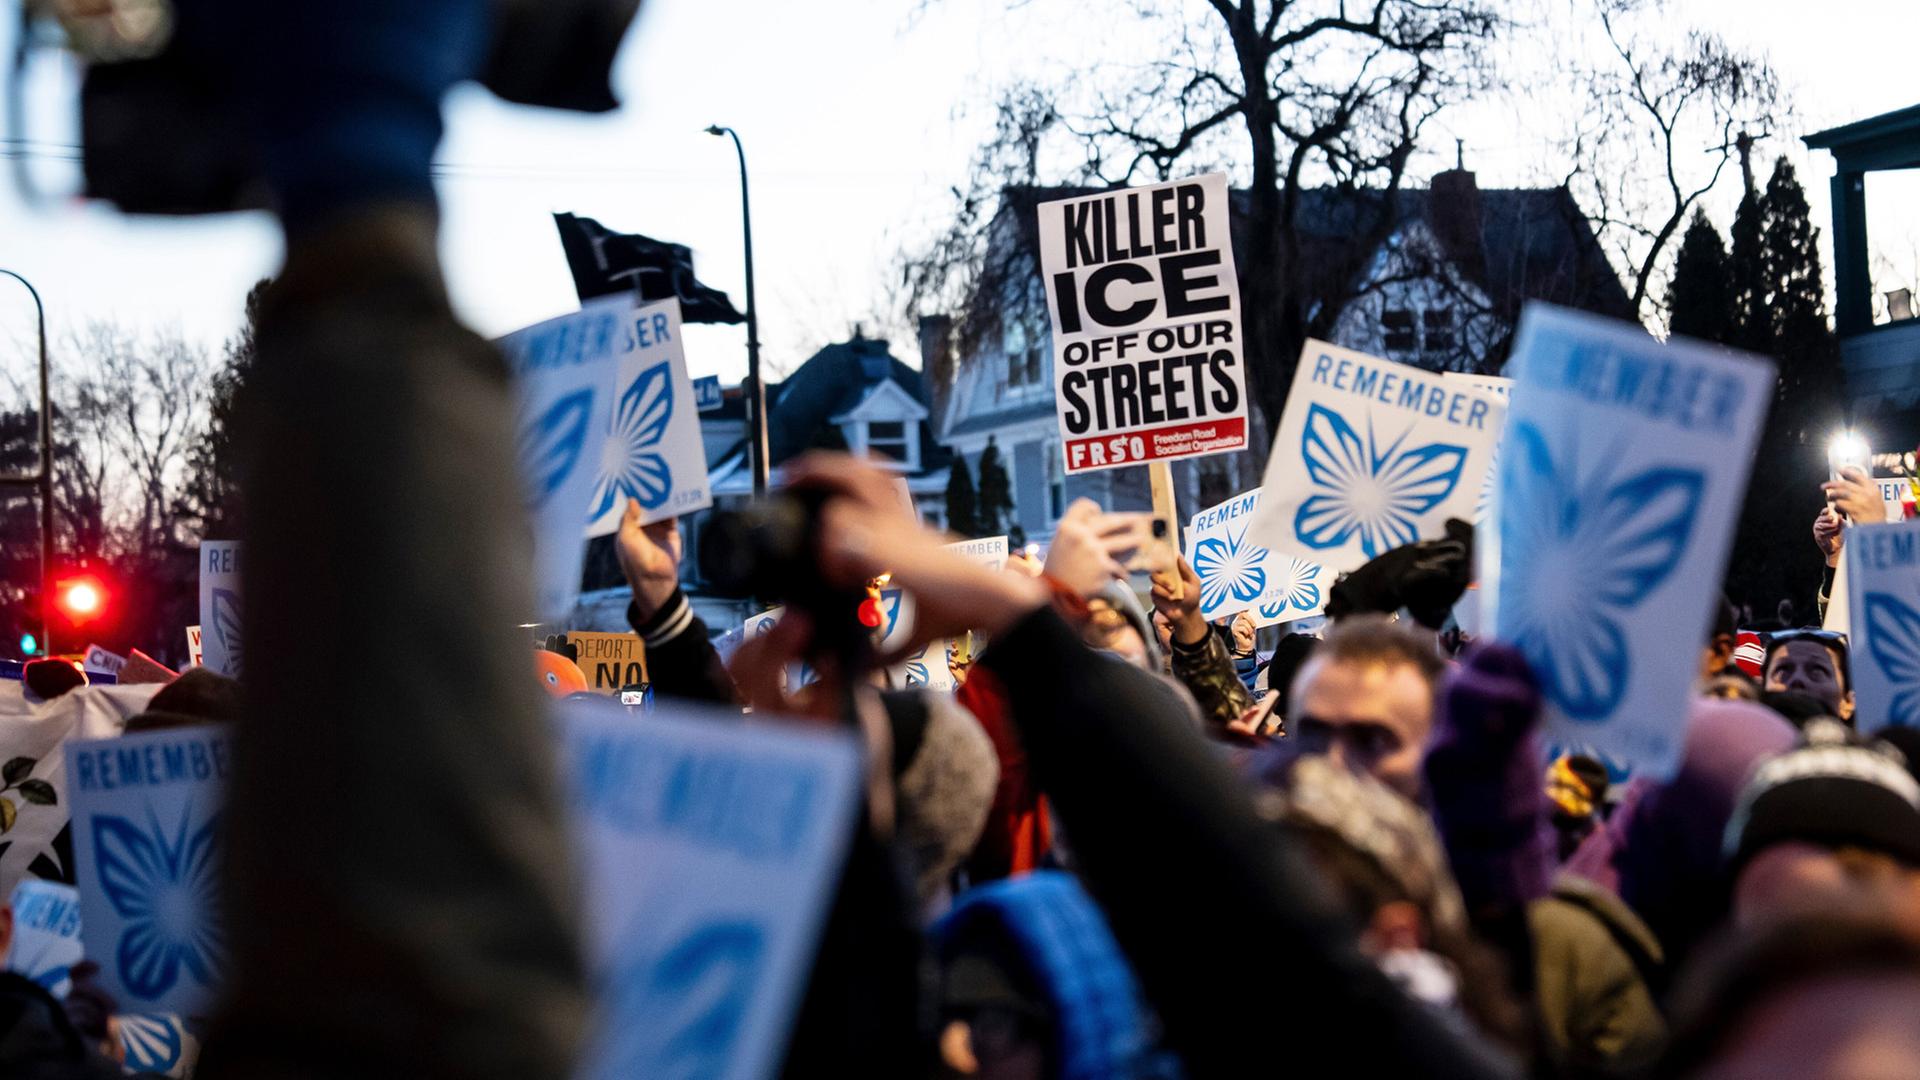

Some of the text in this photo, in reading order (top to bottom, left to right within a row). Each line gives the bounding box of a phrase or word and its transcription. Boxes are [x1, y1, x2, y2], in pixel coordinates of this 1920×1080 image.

[1064, 183, 1206, 268] KILLER
[1054, 249, 1231, 334] ICE
[1063, 320, 1233, 366] OFF OUR
[1062, 349, 1239, 434] STREETS
[1311, 353, 1489, 431] REMEMBER
[1071, 436, 1146, 469] FRSO
[1153, 427, 1216, 445] Freedom Road
[1155, 436, 1243, 456] Socialist Organization
[574, 638, 637, 659] DEPORT
[596, 662, 643, 688] NO
